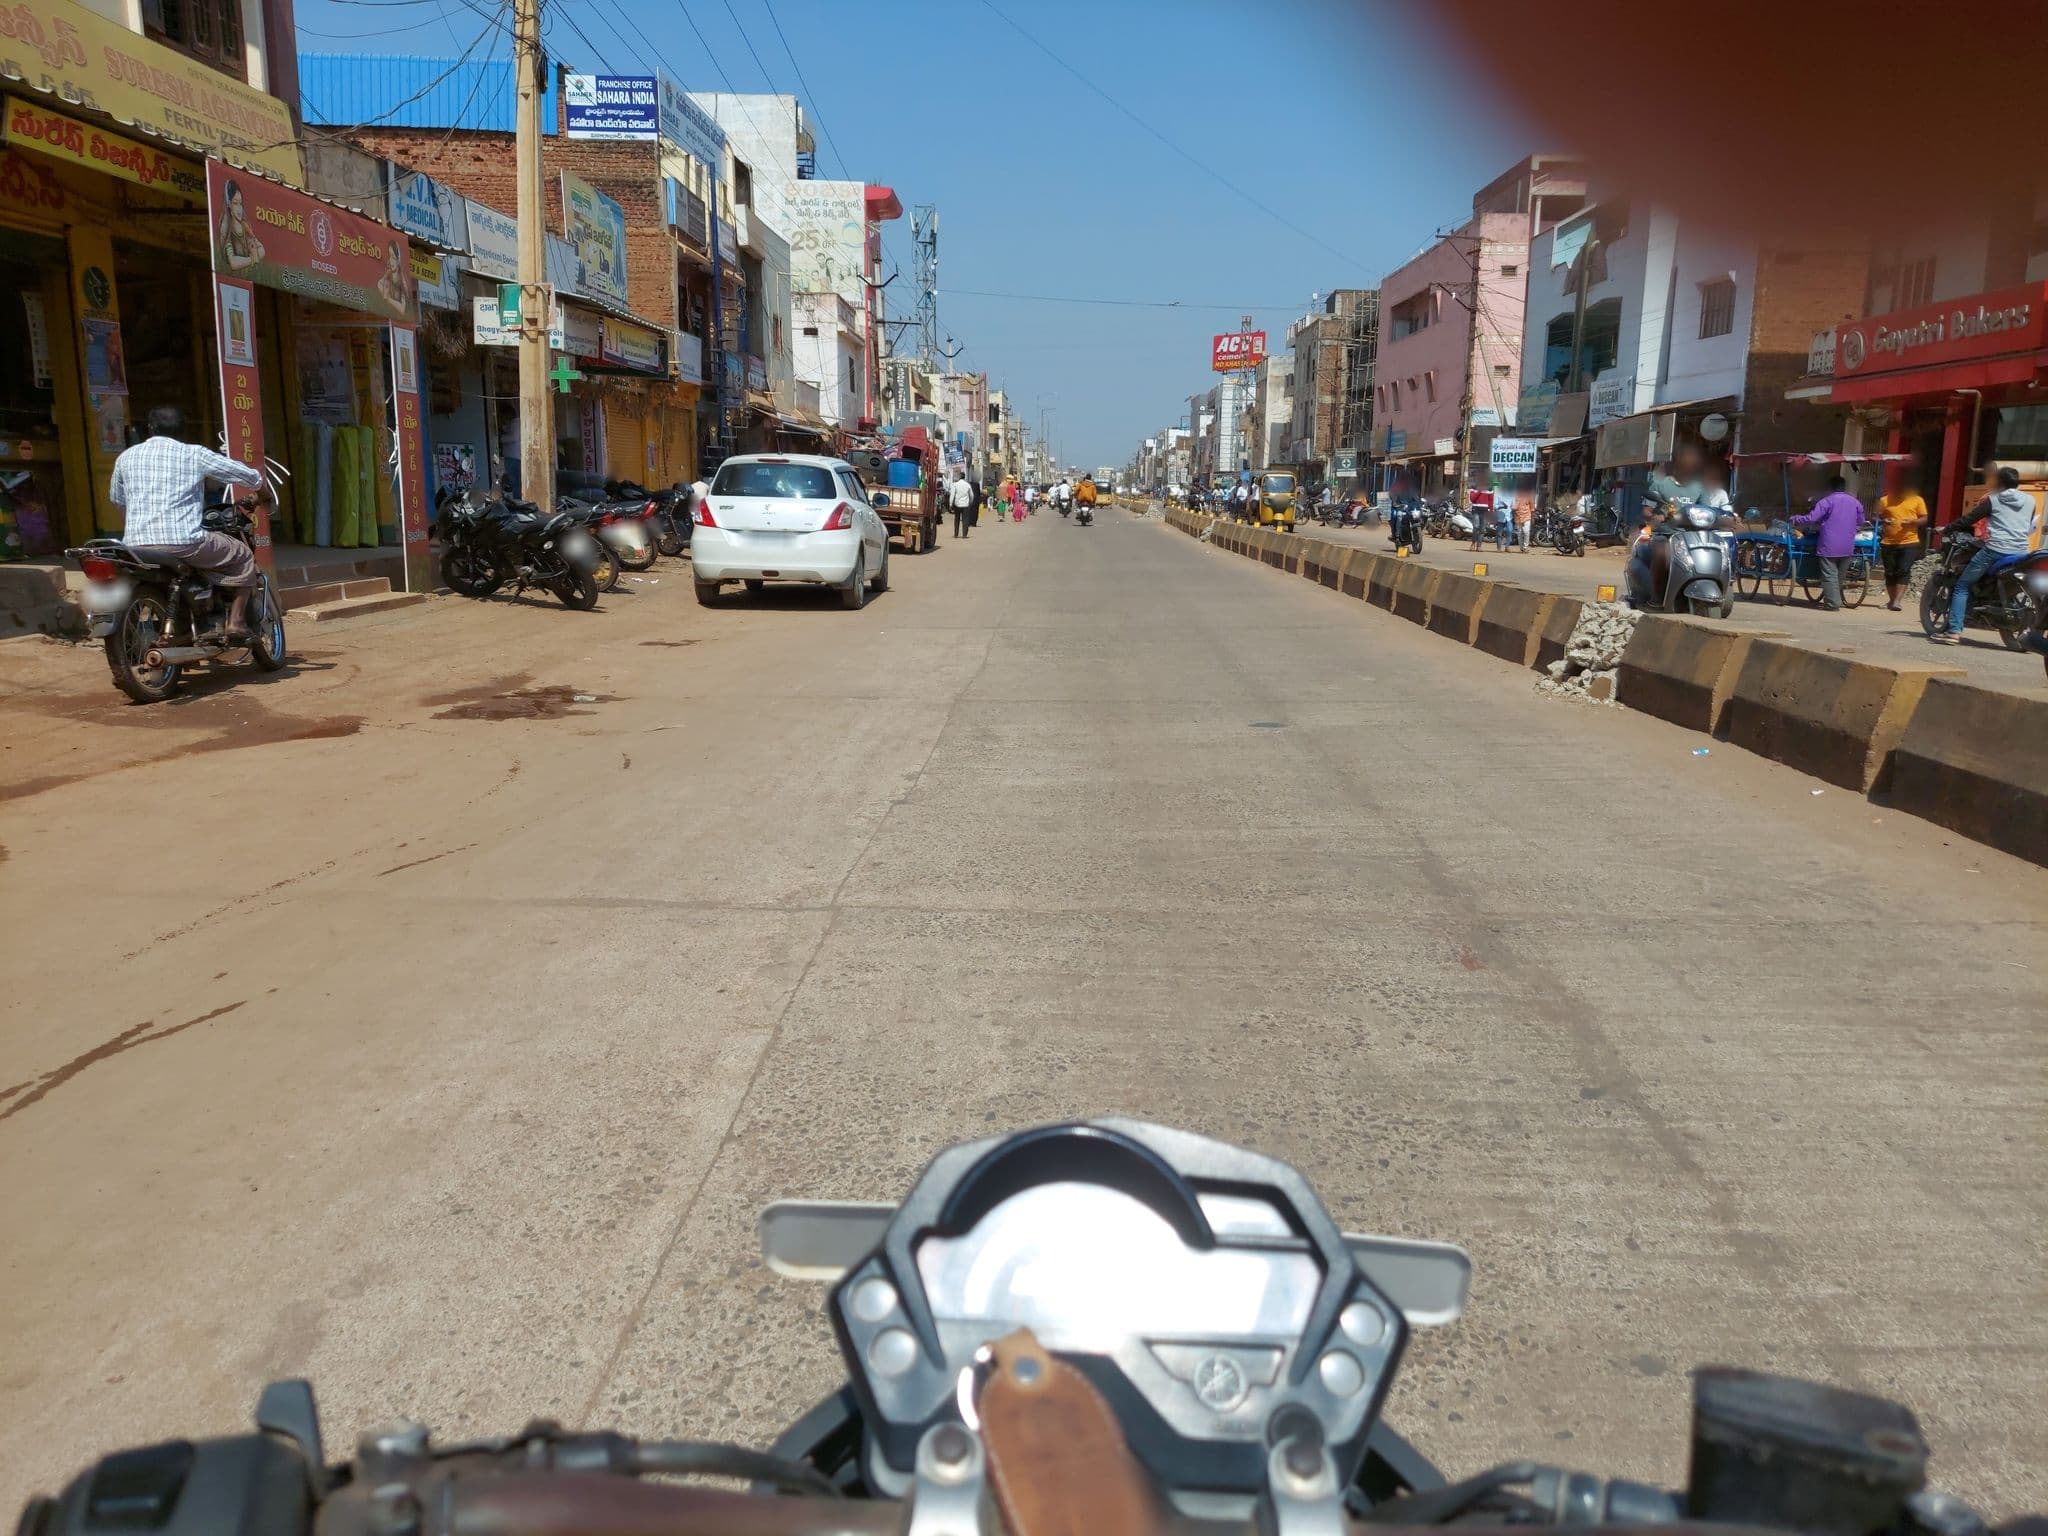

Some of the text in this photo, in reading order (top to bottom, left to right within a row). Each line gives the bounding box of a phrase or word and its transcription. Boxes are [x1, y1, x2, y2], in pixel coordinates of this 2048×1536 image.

[598, 80, 653, 89] FRANCHISE OFFICE
[103, 46, 195, 111] SURESH
[199, 88, 291, 147] AGENCIES
[597, 91, 656, 105] SAHARA INDIA
[164, 107, 256, 149] FERTILZERS
[407, 204, 437, 231] MEDICAL
[311, 259, 338, 275] BIOSEED
[476, 325, 500, 334] Bhagy
[1872, 304, 2030, 355] Gayatri Bakers
[1216, 336, 1252, 353] ACC
[1493, 452, 1535, 463] DECCAN
